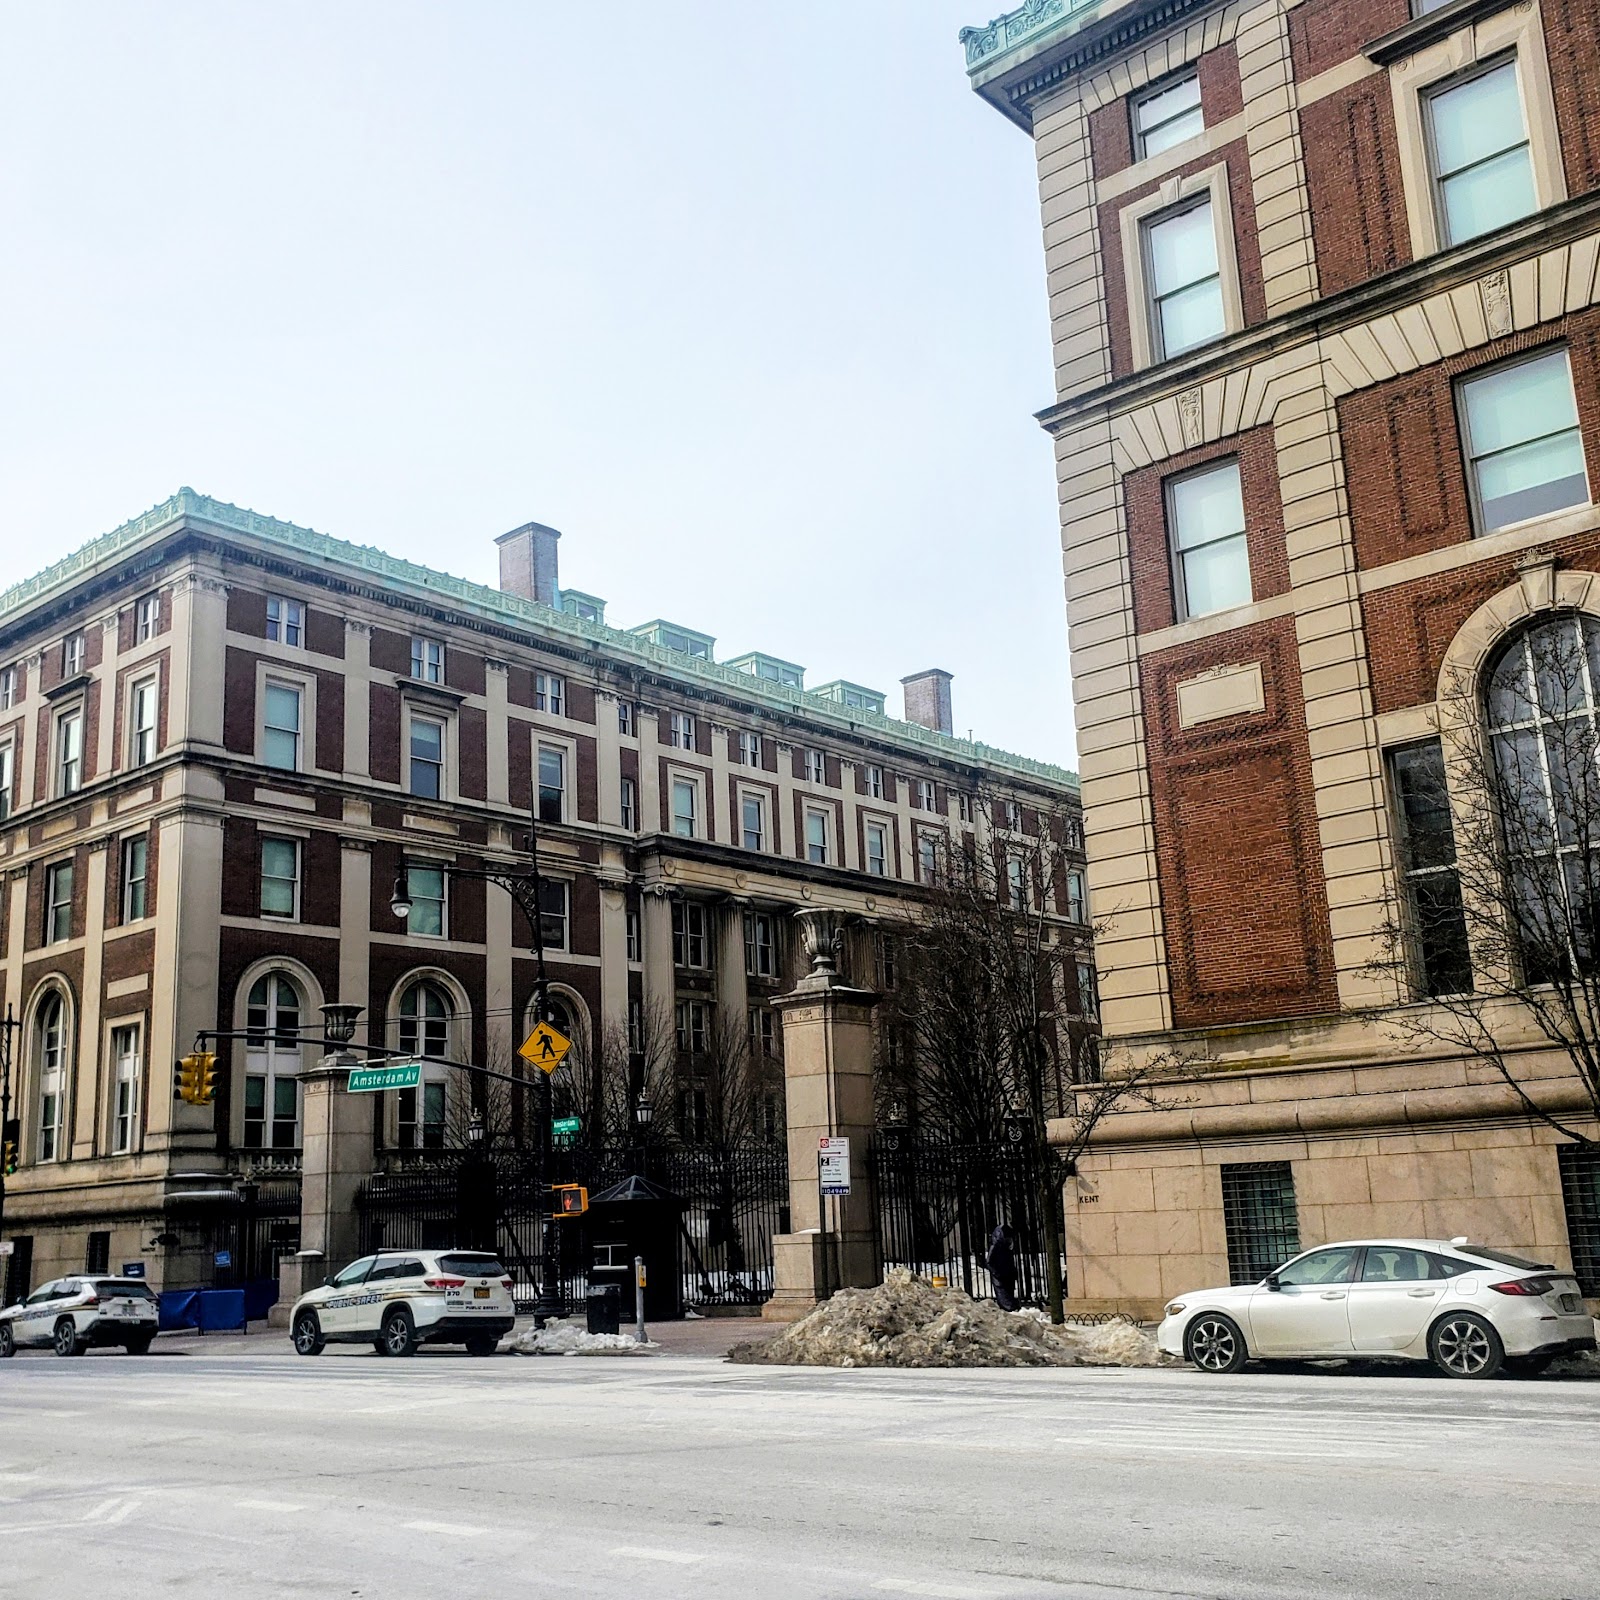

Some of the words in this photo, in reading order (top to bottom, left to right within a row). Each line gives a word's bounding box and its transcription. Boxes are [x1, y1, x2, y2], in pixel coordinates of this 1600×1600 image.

[353, 1073, 404, 1087] Amsterdam
[405, 1071, 417, 1082] Av
[554, 1136, 560, 1145] W
[1079, 1195, 1099, 1203] KENT
[327, 1297, 355, 1309] PUBLIC
